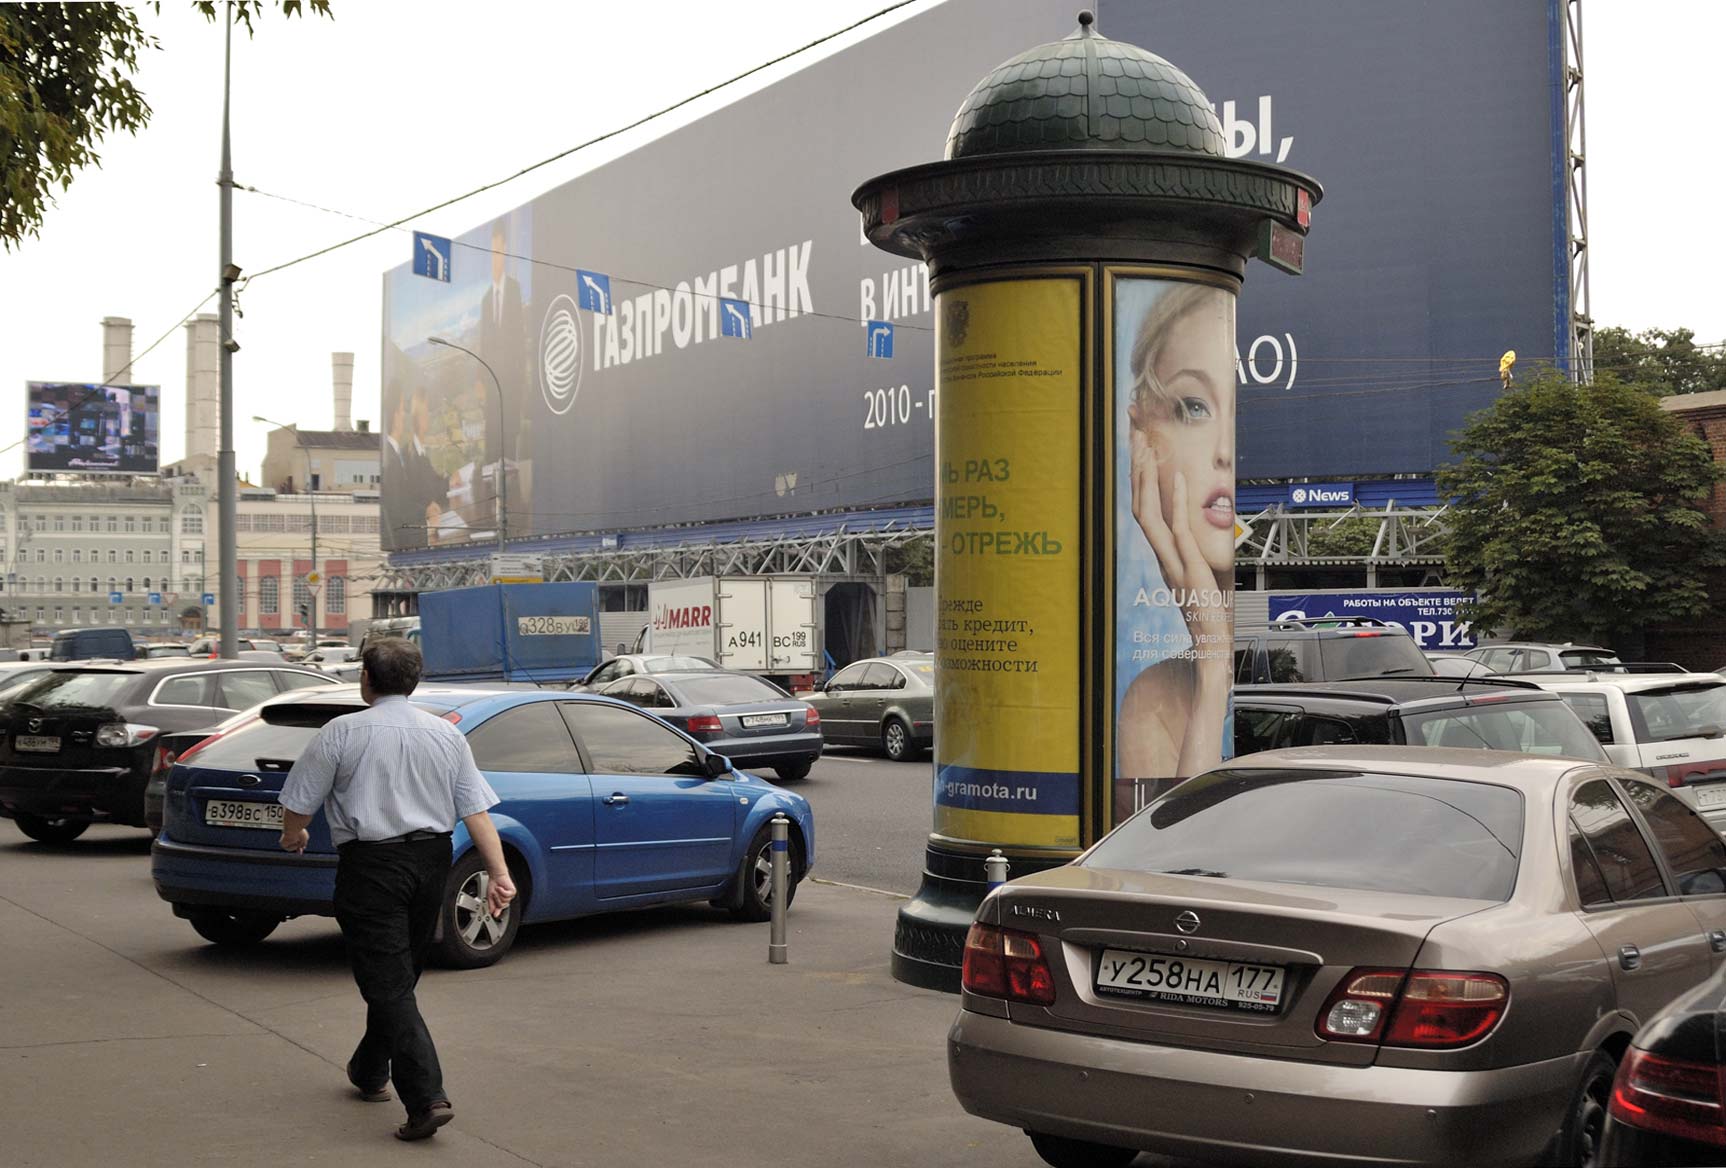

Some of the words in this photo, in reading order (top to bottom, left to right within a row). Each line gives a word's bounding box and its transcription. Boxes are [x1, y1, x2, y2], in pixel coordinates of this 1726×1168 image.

[1212, 95, 1295, 163] Ы,
[861, 278, 877, 328] В
[864, 384, 910, 429] 2010
[965, 459, 1010, 482] РАЗ
[1309, 489, 1349, 501] News
[952, 531, 1063, 555] ОТРЕЖЬ
[1344, 599, 1382, 607] РАБОТЫ
[1385, 599, 1397, 607] НА
[1398, 597, 1441, 607] ОБЪЕКТЕ
[668, 605, 712, 629] MARR
[1186, 611, 1209, 622] SKIN
[792, 631, 806, 642] 199
[964, 620, 1034, 637] кредит,
[1134, 630, 1160, 644] Вся
[951, 639, 1018, 653] оцените
[1132, 648, 1160, 662] для
[211, 803, 260, 821] В398ВС
[1011, 904, 1061, 922] ALMERA
[1110, 957, 1220, 995] У258НА
[1232, 966, 1277, 991] 177
[1160, 992, 1184, 1003] RIDA
[1186, 995, 1229, 1008] MOTORS
[1237, 989, 1260, 1000] RUS
